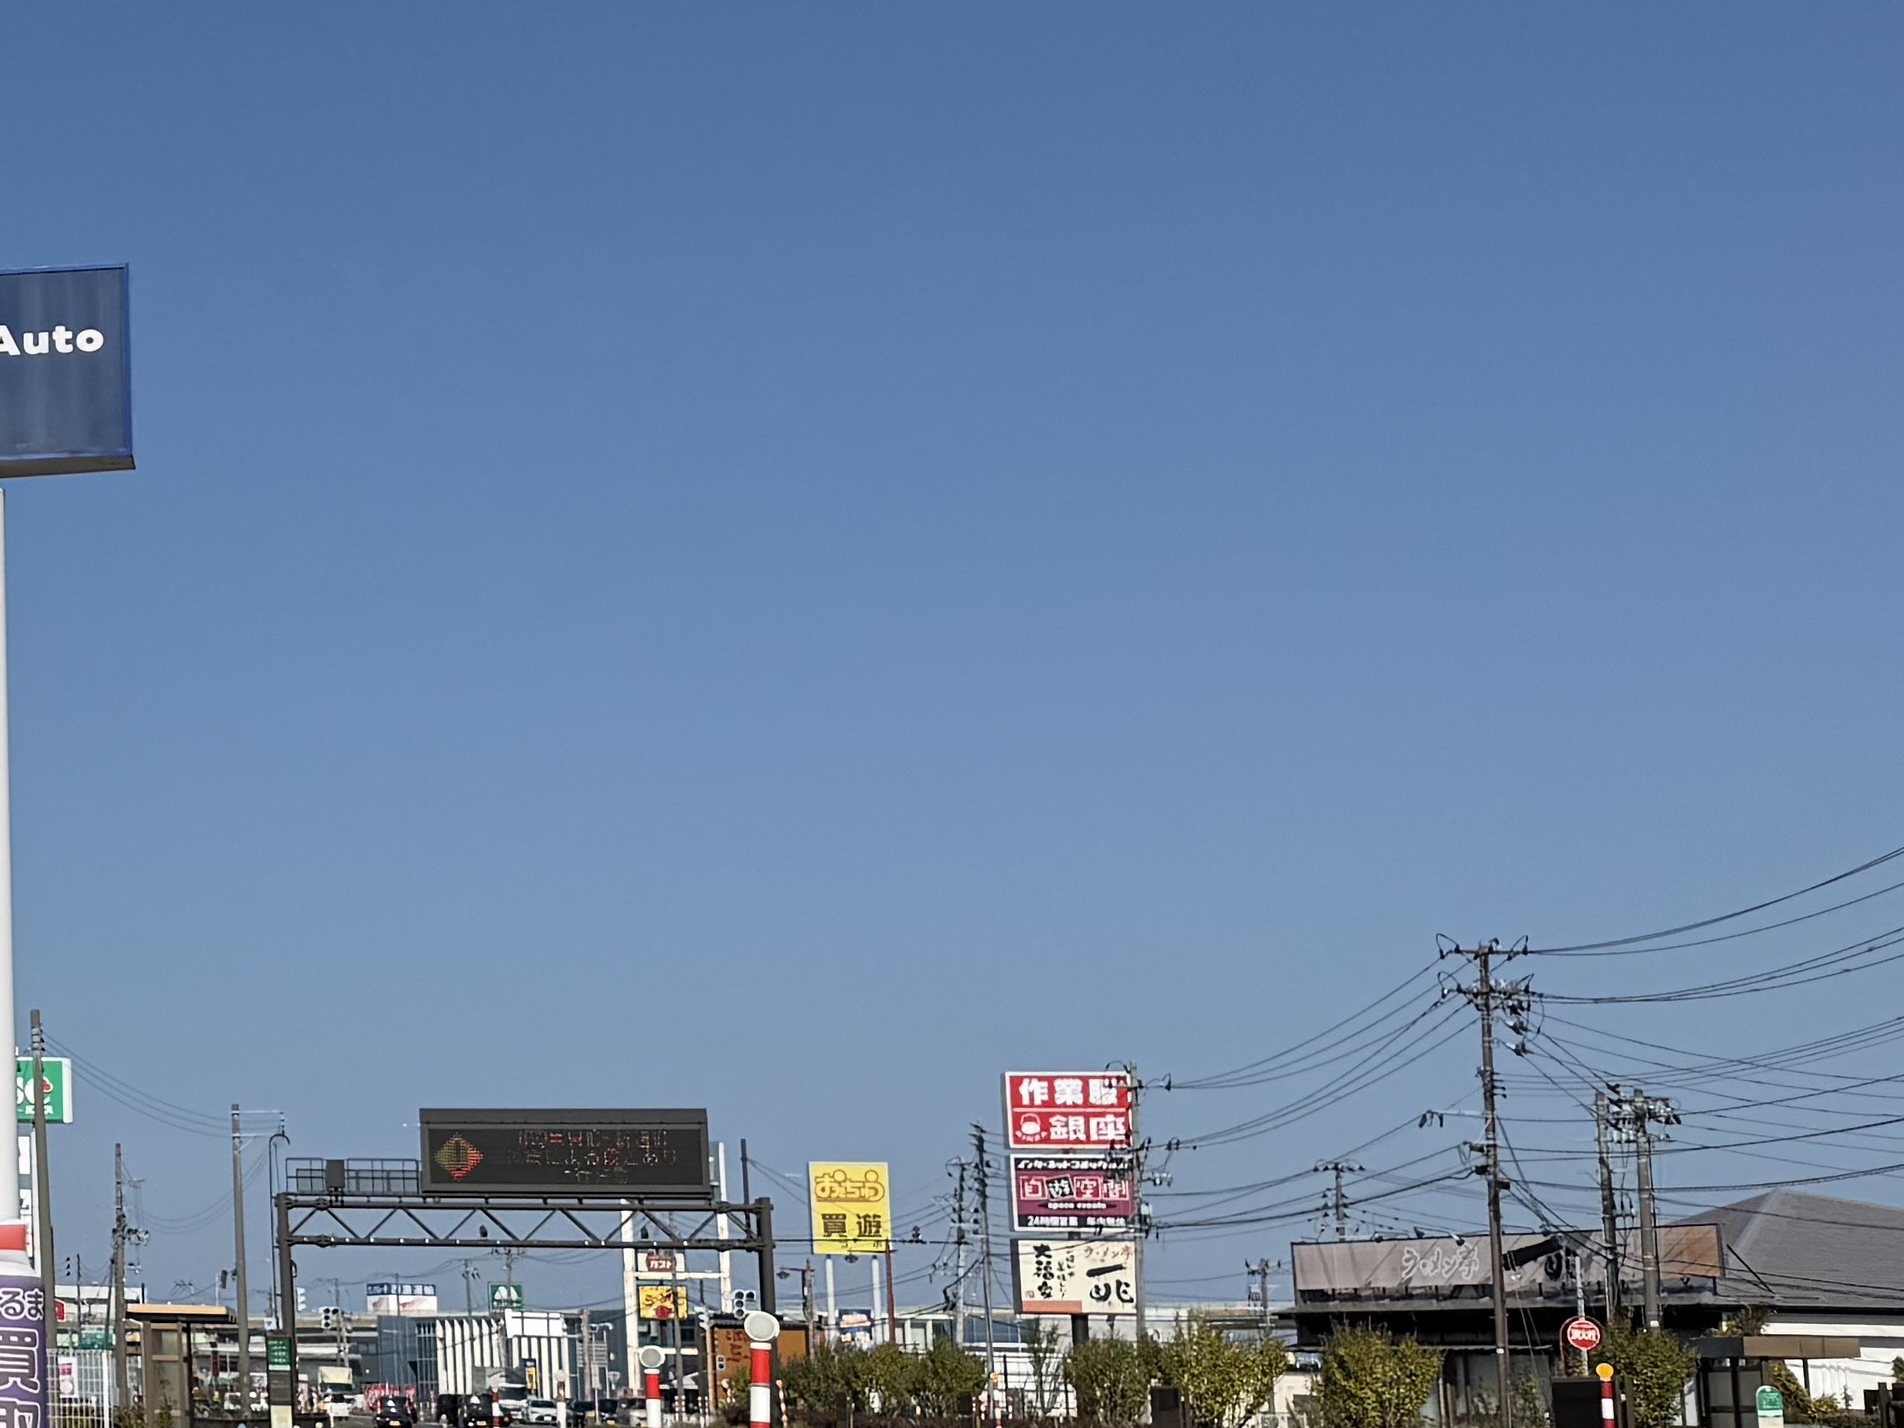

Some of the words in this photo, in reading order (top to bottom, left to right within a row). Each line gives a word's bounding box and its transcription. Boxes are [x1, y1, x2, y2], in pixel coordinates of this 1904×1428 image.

[1049, 1114, 1126, 1141] 銀座
[1023, 1177, 1127, 1198] 自遊空間
